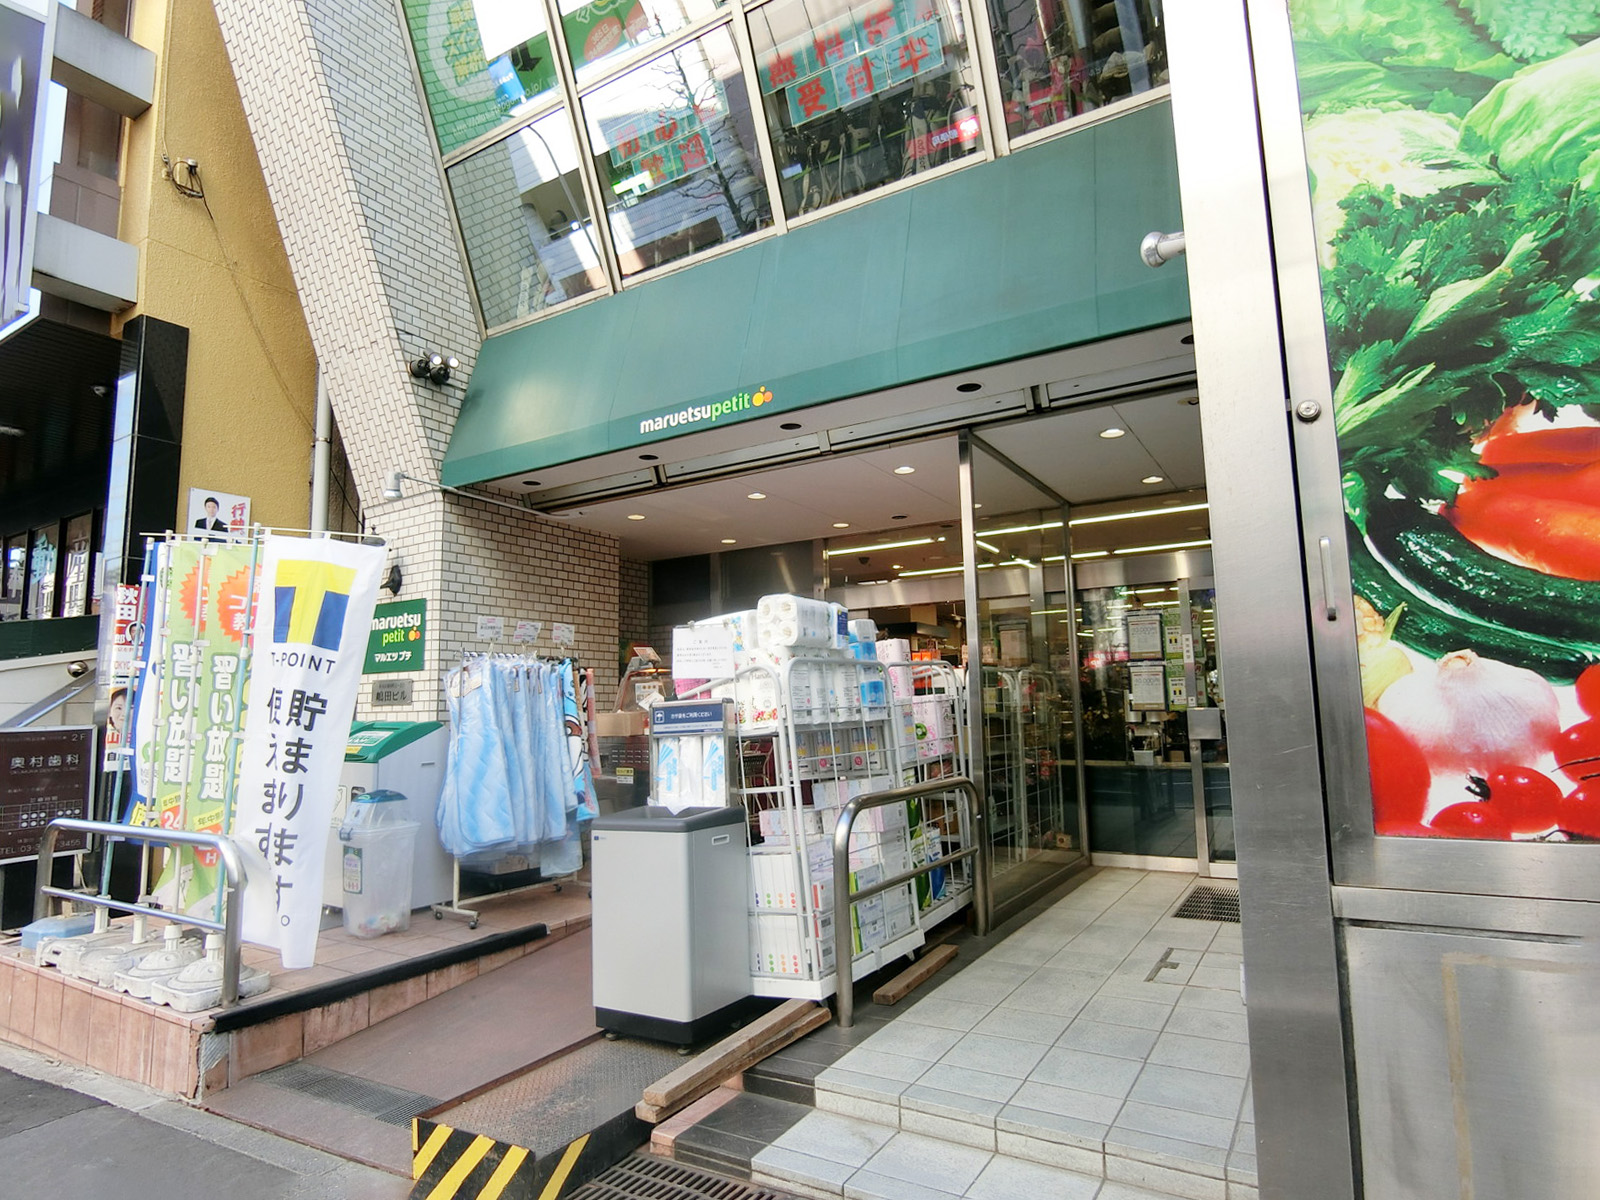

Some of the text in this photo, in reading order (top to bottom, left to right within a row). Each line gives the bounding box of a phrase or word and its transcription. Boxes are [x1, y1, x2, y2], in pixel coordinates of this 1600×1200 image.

[382, 628, 405, 647] petit
[270, 650, 337, 675] T-POINT
[202, 655, 239, 800] 習い放題
[10, 753, 80, 769] 奥村歯科
